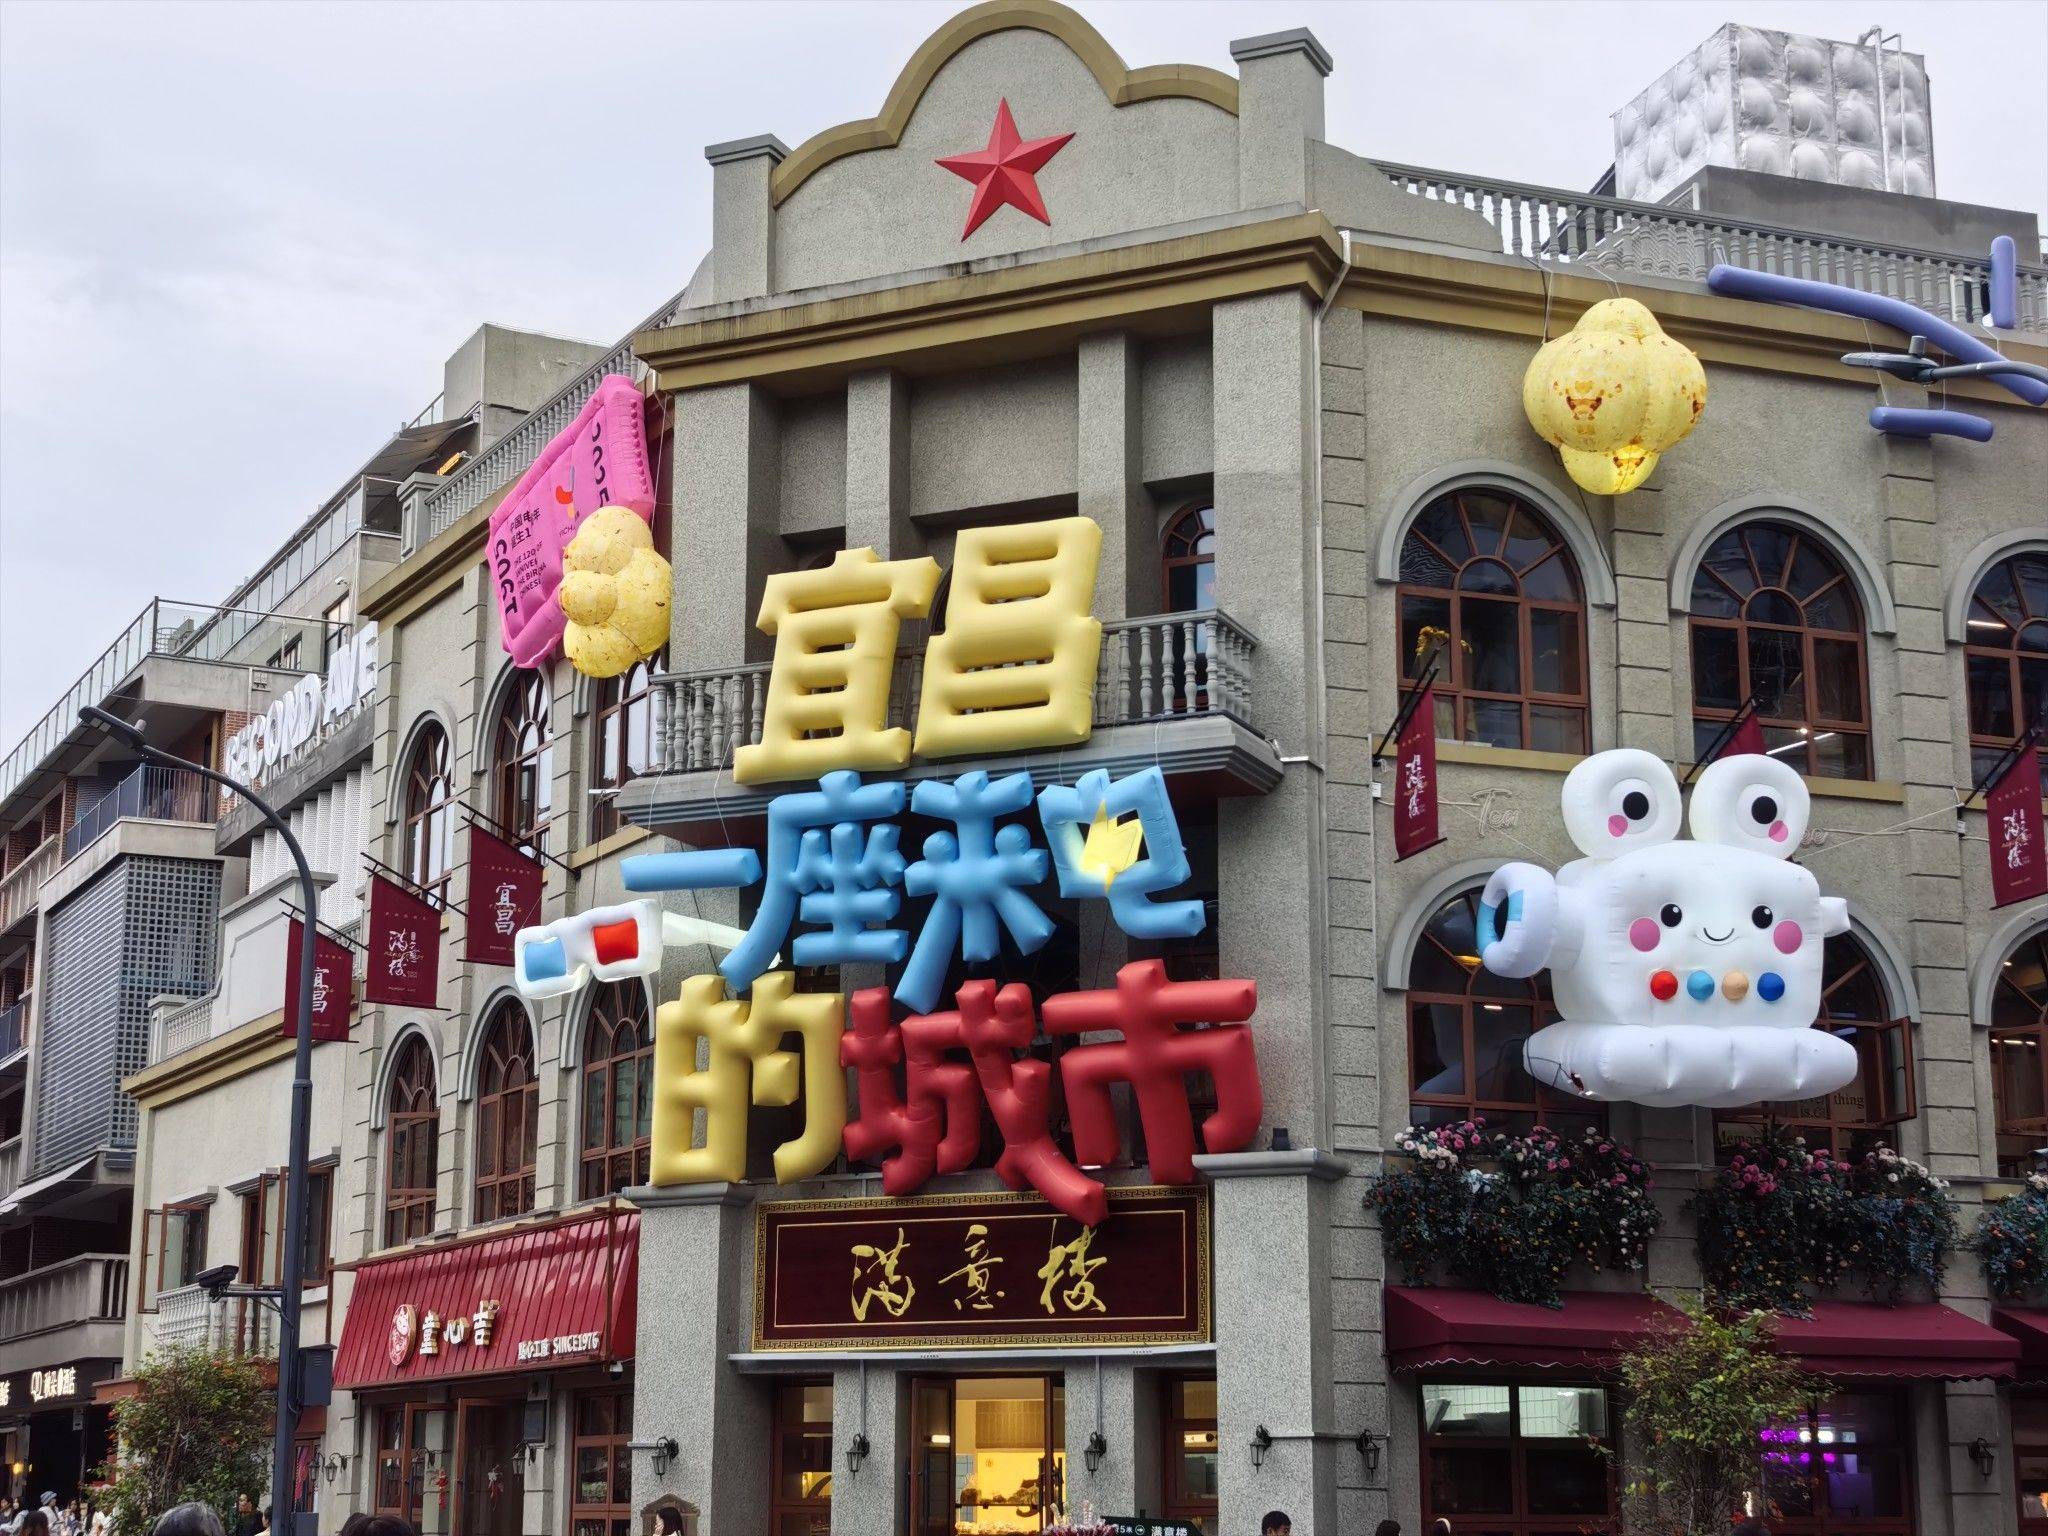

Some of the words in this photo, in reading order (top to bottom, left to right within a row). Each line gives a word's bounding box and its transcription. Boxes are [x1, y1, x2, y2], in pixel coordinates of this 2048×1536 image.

[222, 673, 322, 799] SECOND
[322, 621, 379, 726] AVE
[733, 516, 1102, 785] 宜昌
[495, 882, 518, 935] 宜昌
[620, 766, 1207, 1014] 一座来电
[649, 958, 1263, 1227] 的城市
